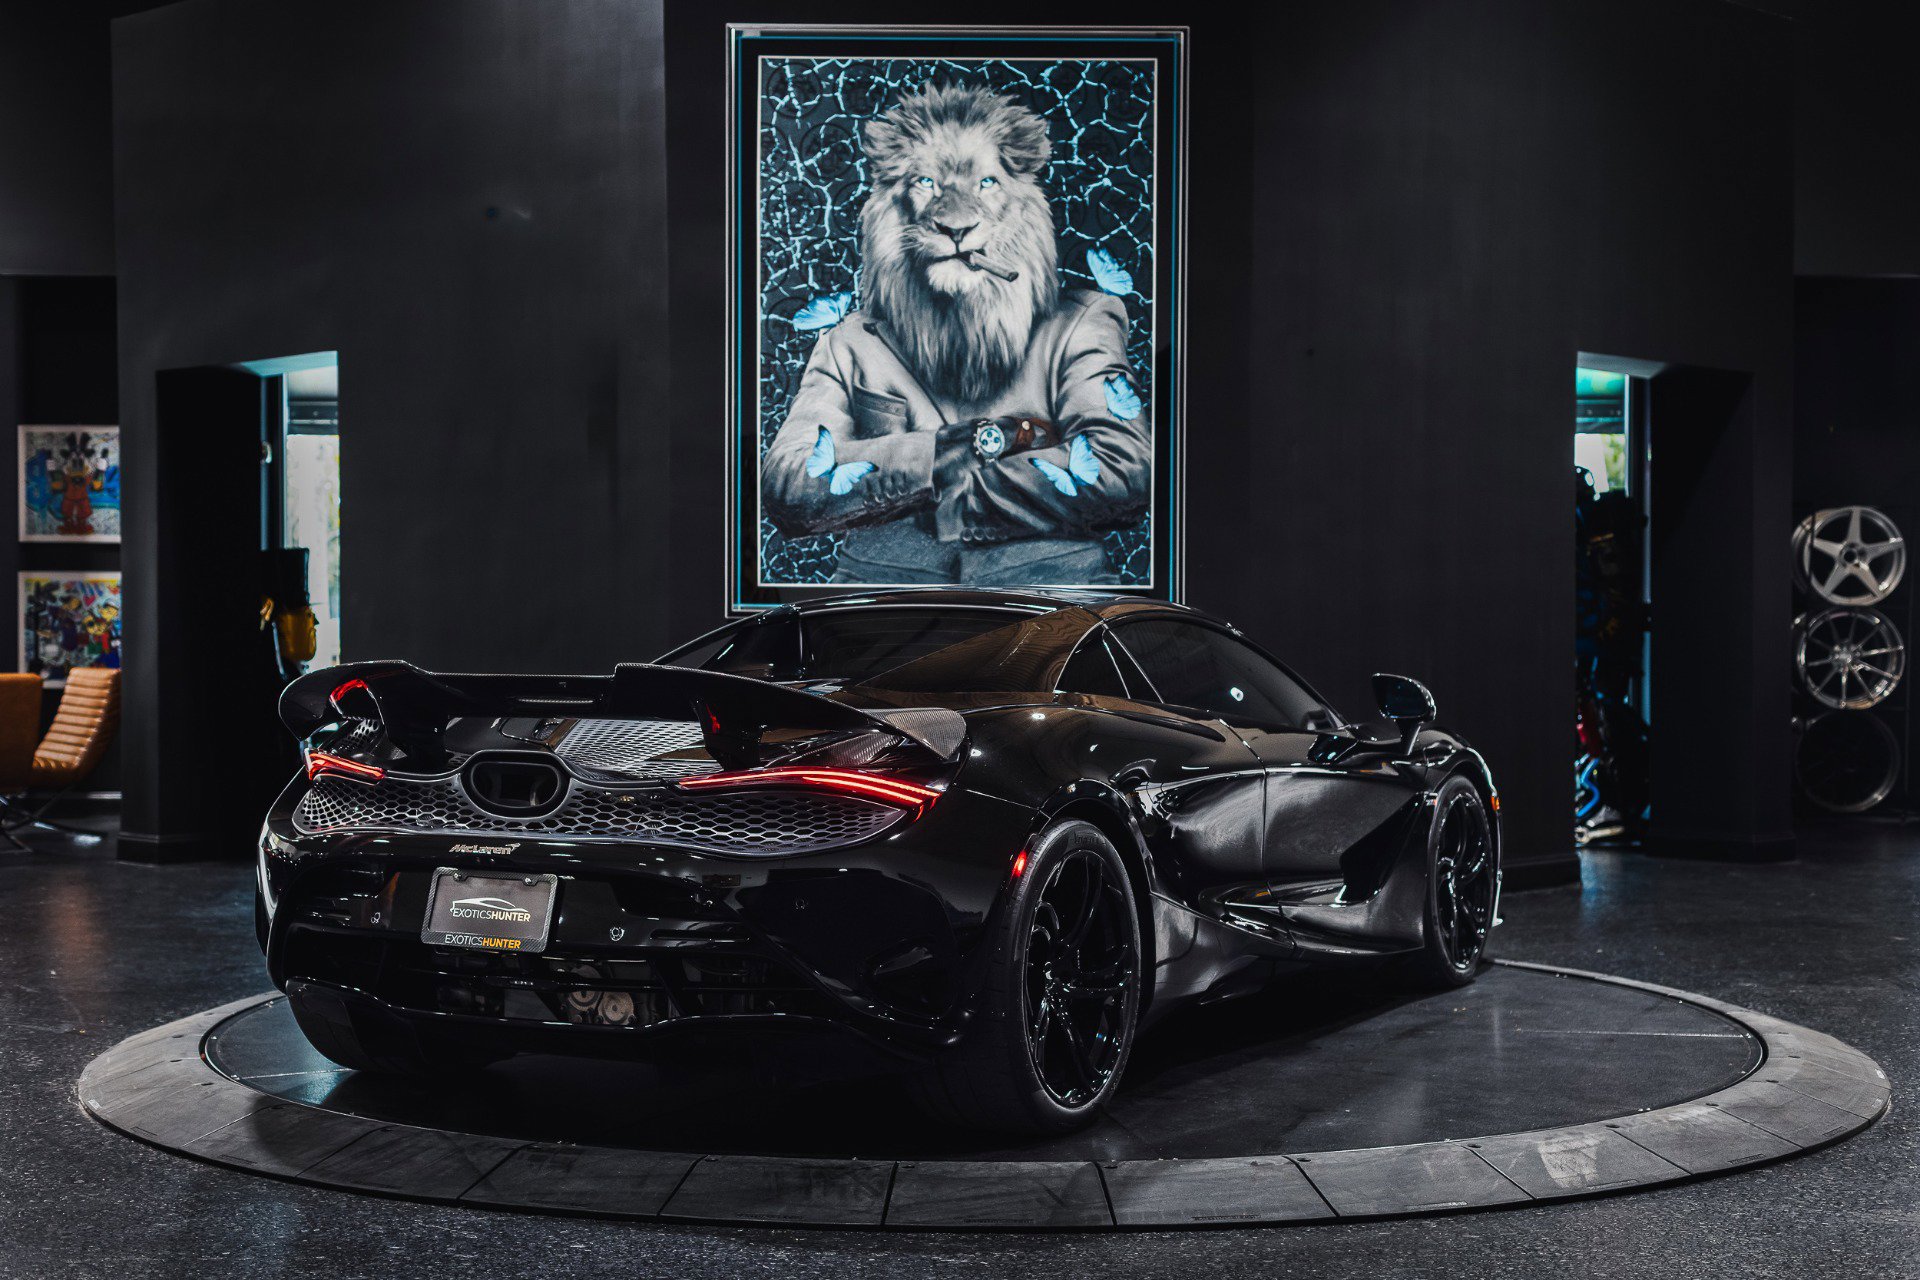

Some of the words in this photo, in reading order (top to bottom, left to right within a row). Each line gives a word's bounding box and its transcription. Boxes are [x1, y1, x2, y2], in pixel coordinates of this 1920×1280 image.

[449, 844, 514, 855] McLaren
[453, 908, 531, 922] EXOTICSHUNTER
[445, 934, 521, 949] EXOTICSHUNTER
